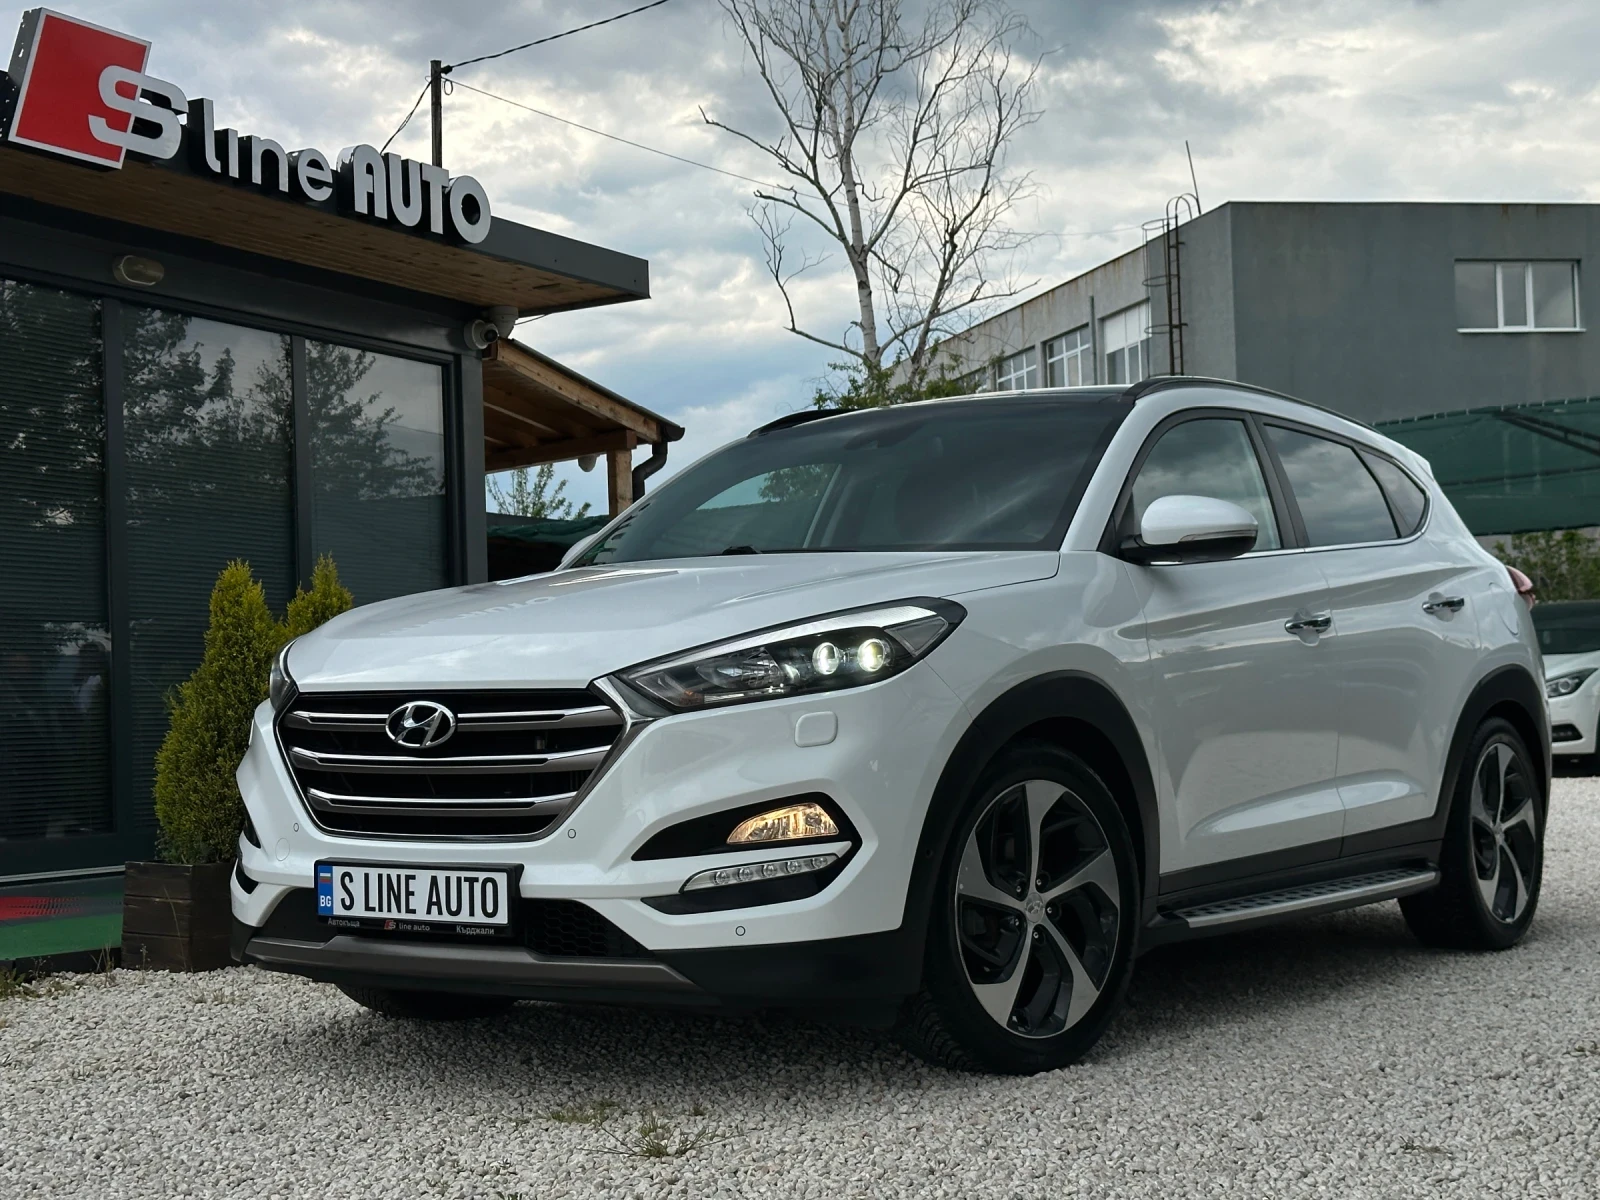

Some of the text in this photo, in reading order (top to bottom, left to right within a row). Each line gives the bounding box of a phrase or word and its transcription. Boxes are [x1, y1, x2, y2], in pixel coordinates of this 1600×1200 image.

[352, 143, 492, 245] AUTO
[339, 870, 499, 919] S LINE AUTO
[319, 895, 332, 907] BG
[398, 922, 412, 931] line
[412, 923, 431, 932] auto
[455, 924, 495, 936] Кърджали
